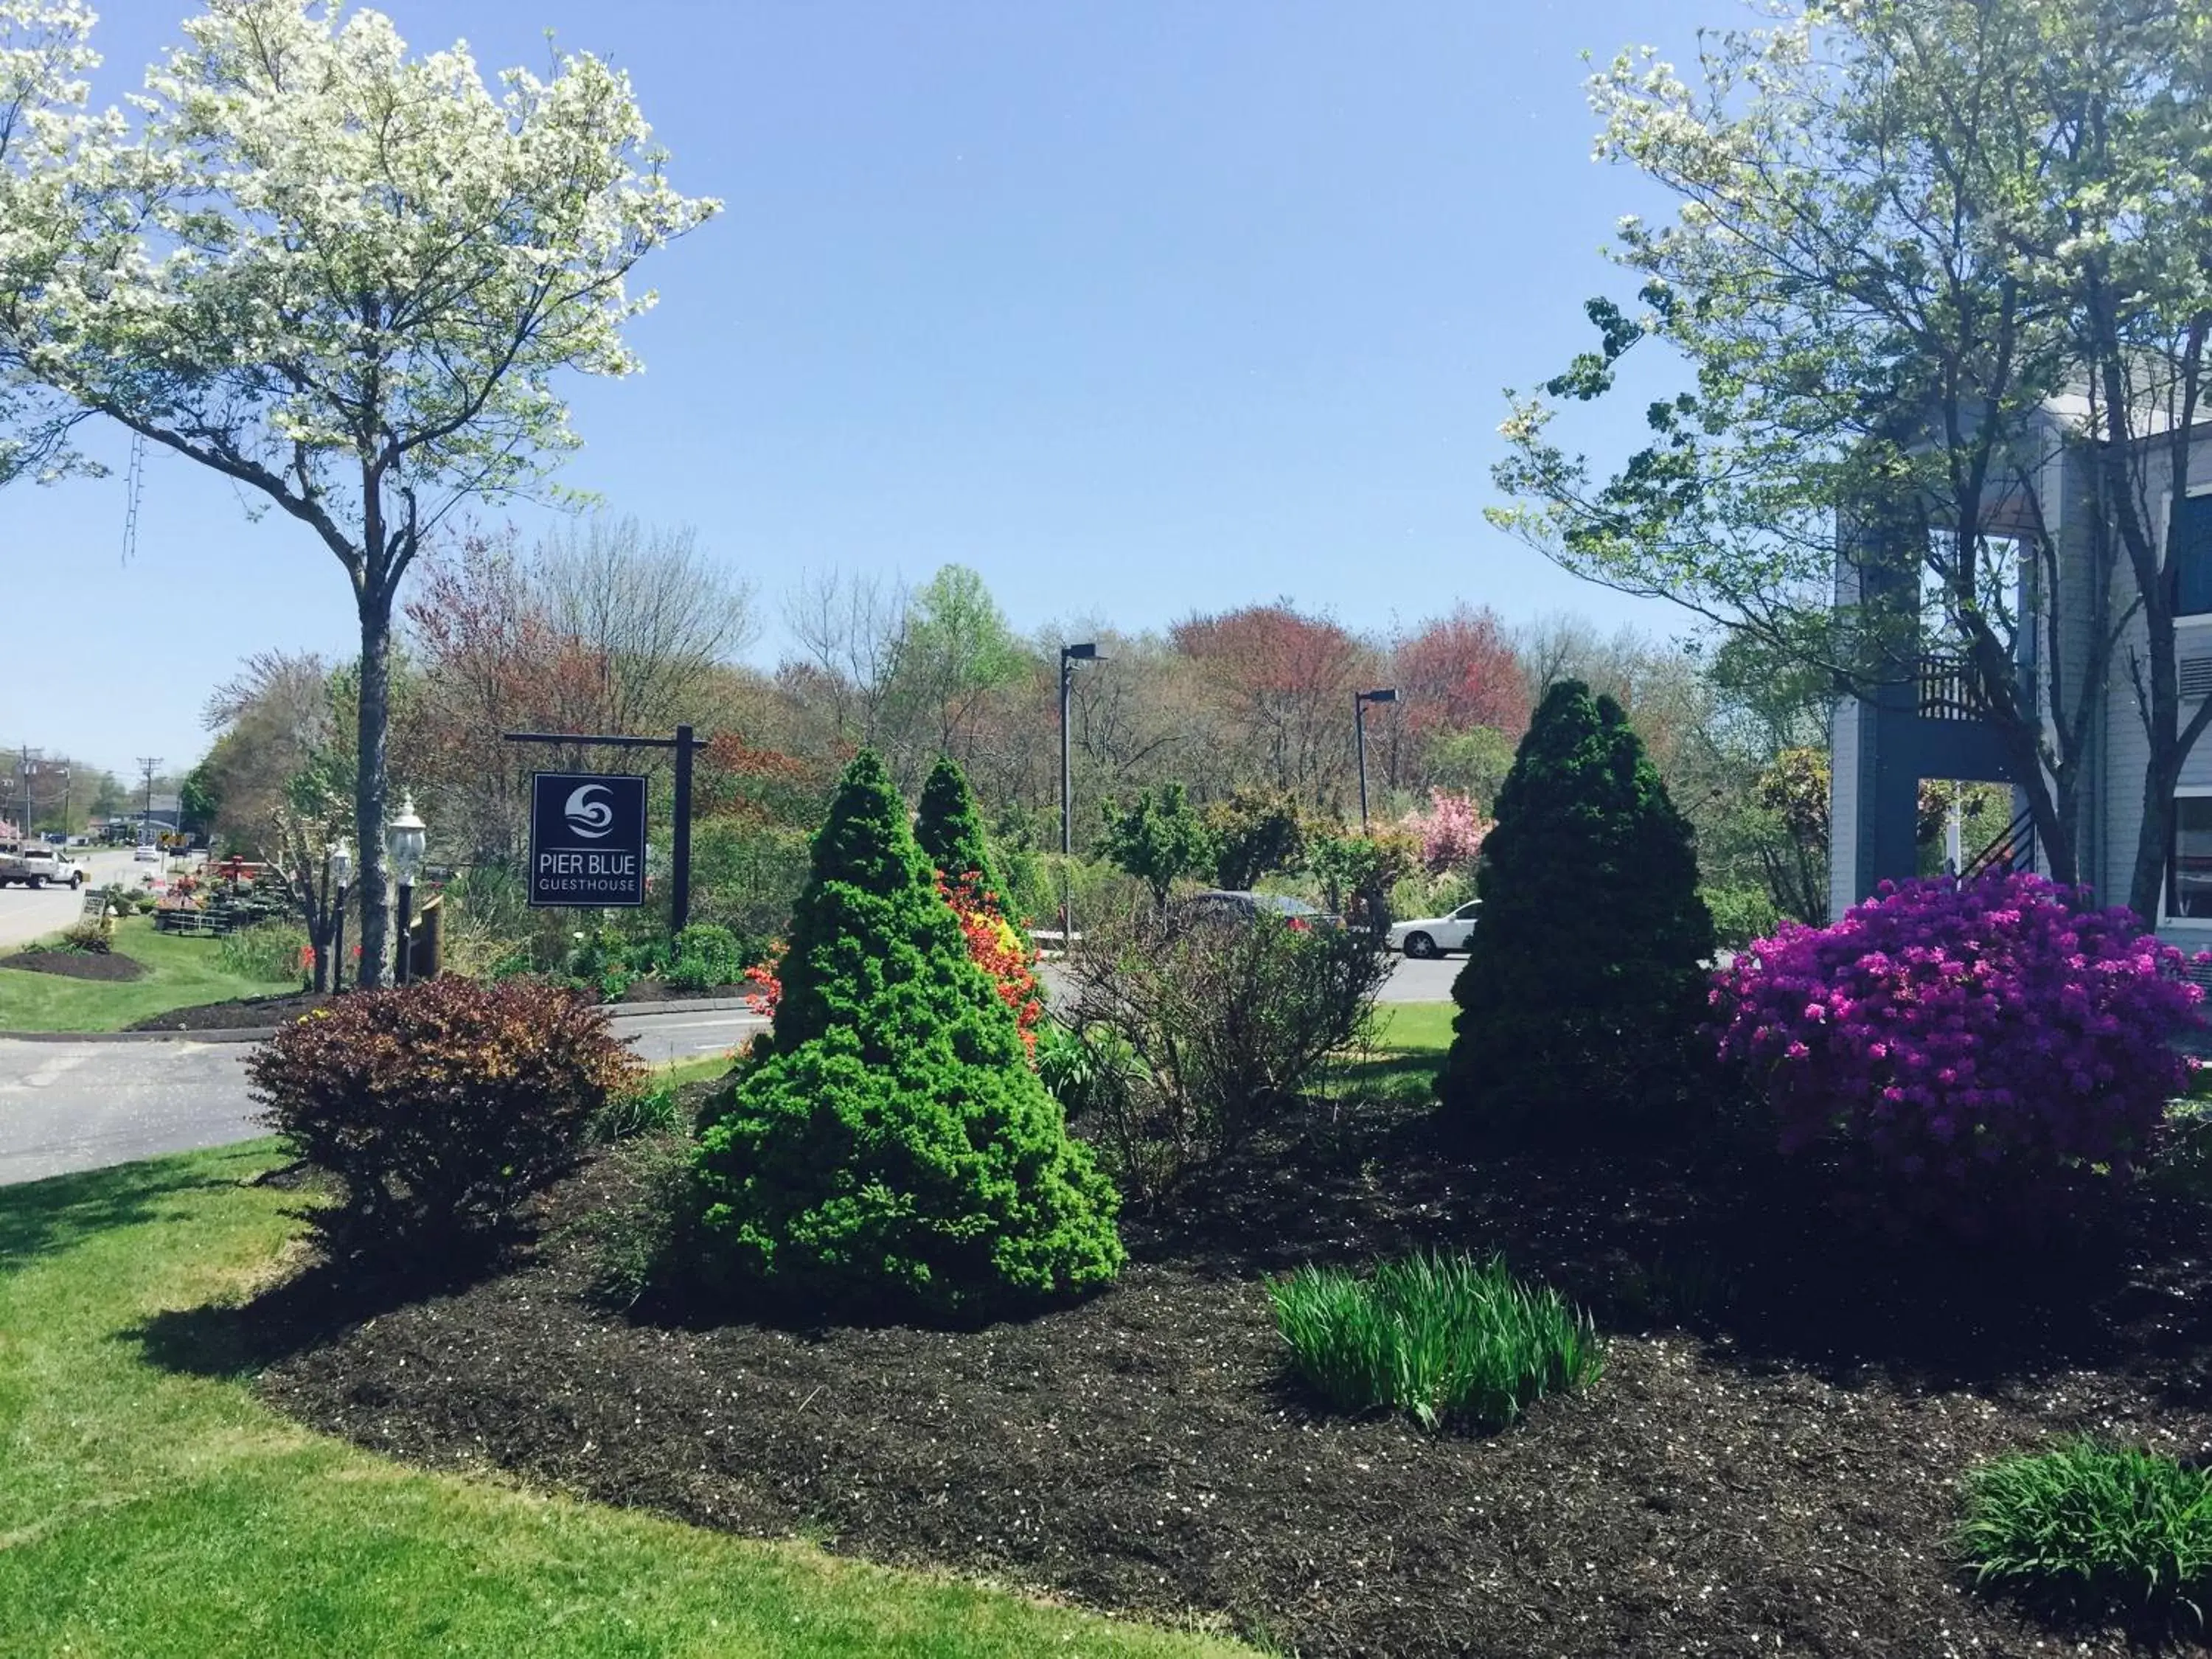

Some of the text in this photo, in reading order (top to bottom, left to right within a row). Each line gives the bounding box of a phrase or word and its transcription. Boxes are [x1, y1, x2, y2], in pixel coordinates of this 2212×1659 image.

[540, 854, 636, 875] PIER BLUE
[539, 878, 636, 891] GUESTHOUSE
